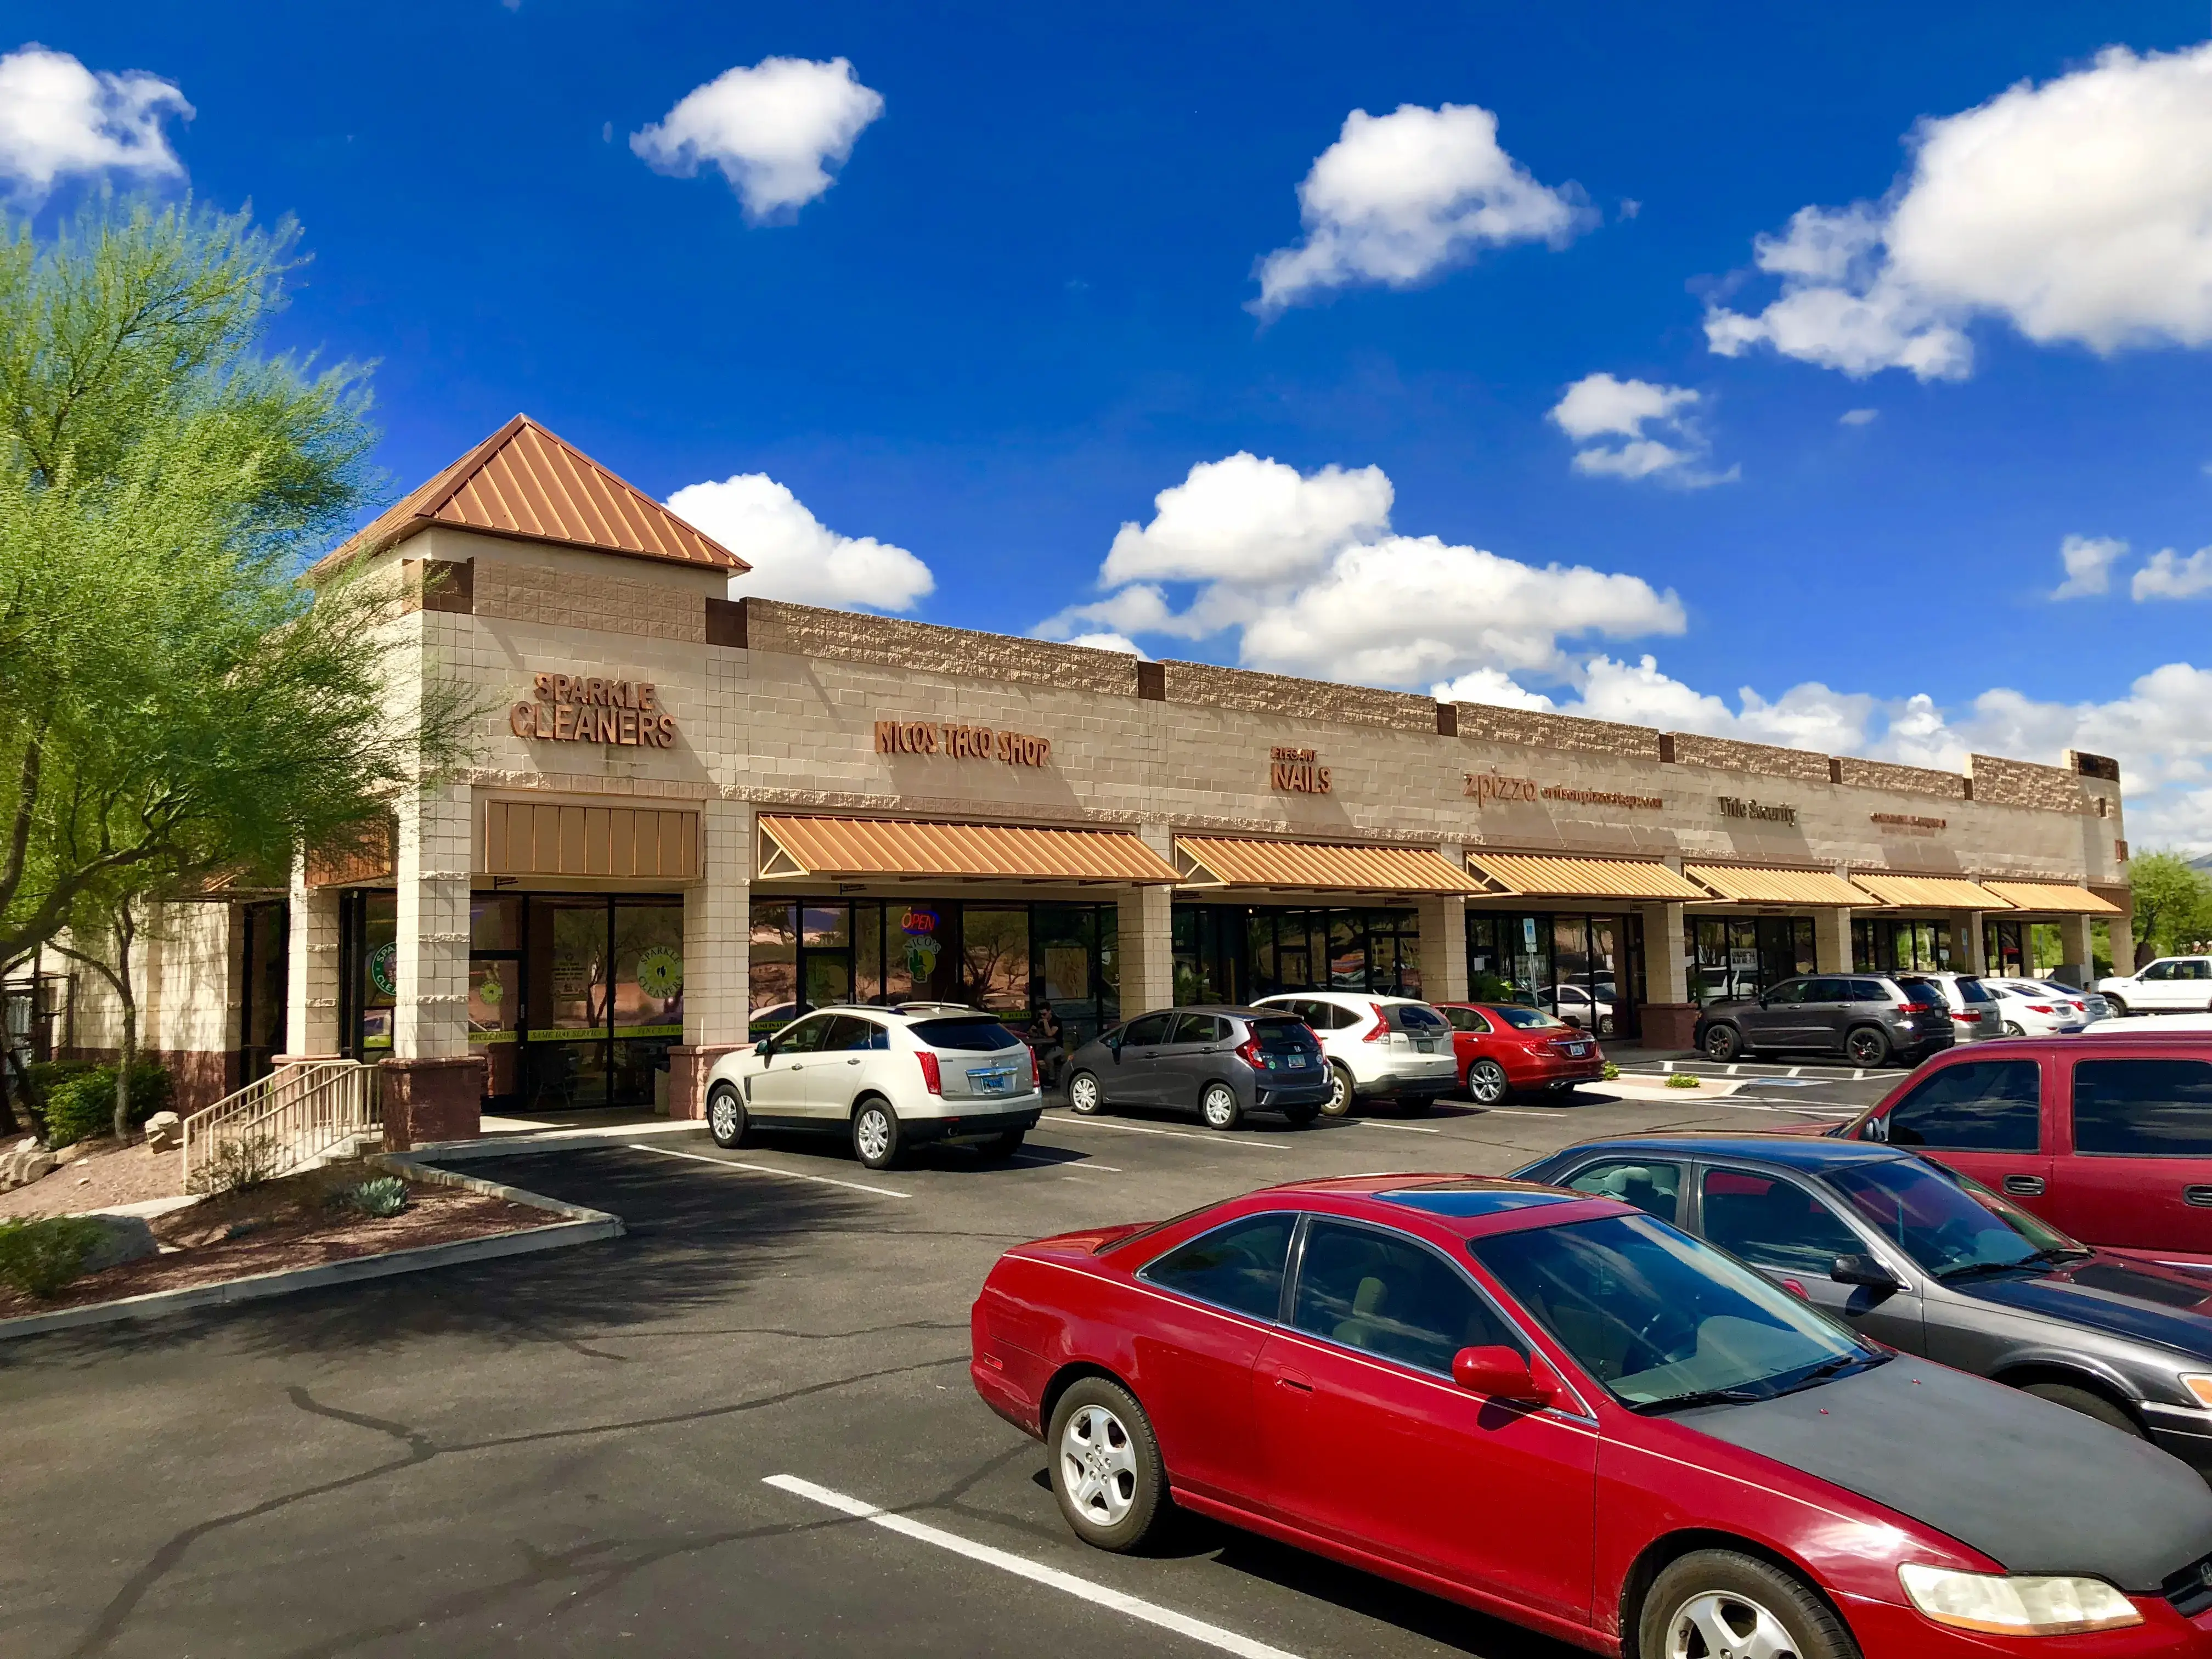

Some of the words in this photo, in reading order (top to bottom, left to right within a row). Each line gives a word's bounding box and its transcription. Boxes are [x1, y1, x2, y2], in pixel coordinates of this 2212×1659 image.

[533, 672, 655, 709] SPARKLE
[511, 701, 676, 748] CLEANERS
[874, 721, 937, 754] NICOS
[942, 723, 994, 759] TACO
[997, 731, 1051, 767] SHOP
[1271, 762, 1331, 794] NAILS
[1718, 797, 1747, 818] Title
[1748, 799, 1796, 827] Security
[901, 913, 935, 930] OPEN
[377, 946, 396, 963] SPA
[640, 946, 681, 964] SPARKLE
[904, 936, 940, 952] NICO'S
[639, 975, 683, 997] CLEANERS
